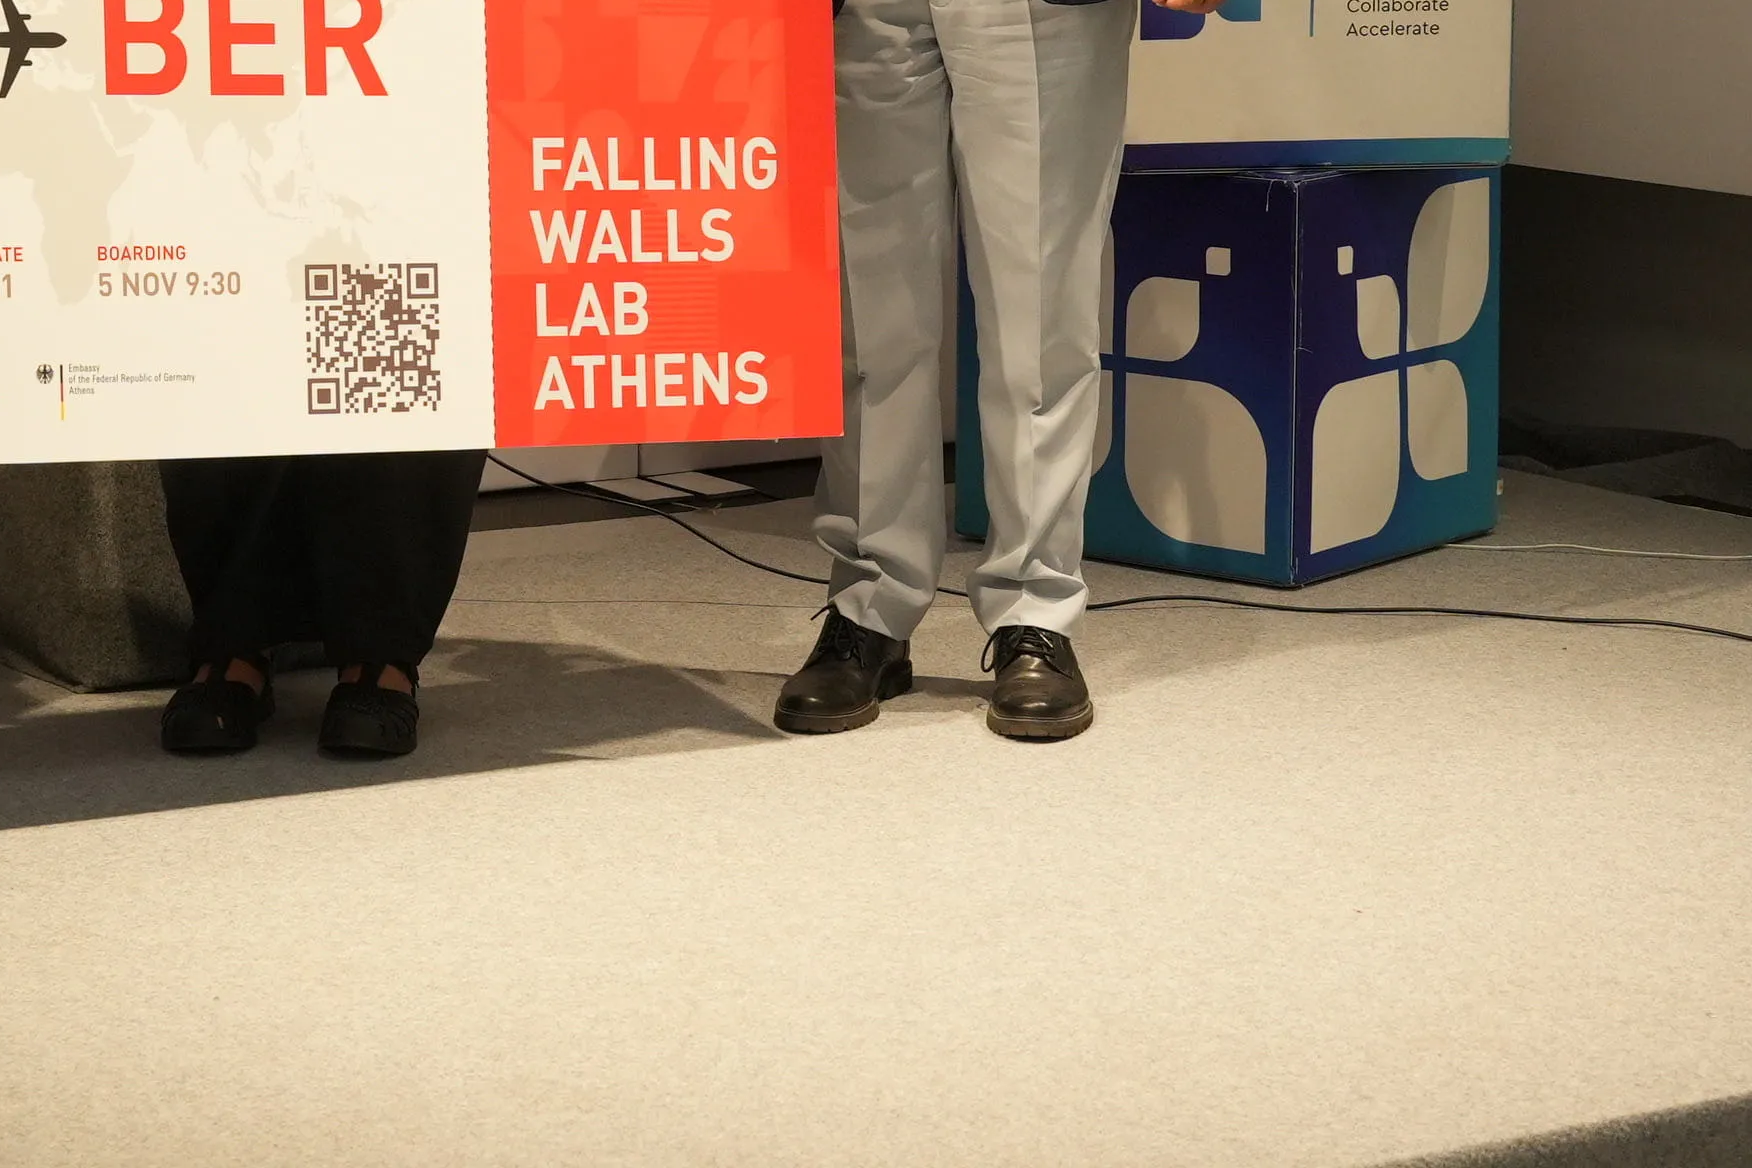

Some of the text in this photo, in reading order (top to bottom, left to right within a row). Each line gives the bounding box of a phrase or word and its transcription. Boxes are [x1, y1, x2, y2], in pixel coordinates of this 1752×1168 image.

[1346, 20, 1440, 37] Accelerate
[532, 136, 778, 191] FALLING
[529, 208, 735, 264] WALLS
[97, 245, 187, 261] BOARDING
[98, 271, 241, 297] 5 NOV 9:30
[535, 282, 649, 337] LAB
[68, 363, 100, 373] Embassy
[68, 372, 196, 384] of the Federal Republic of Germany
[69, 386, 95, 395] Athens
[534, 350, 768, 410] ATHENS
